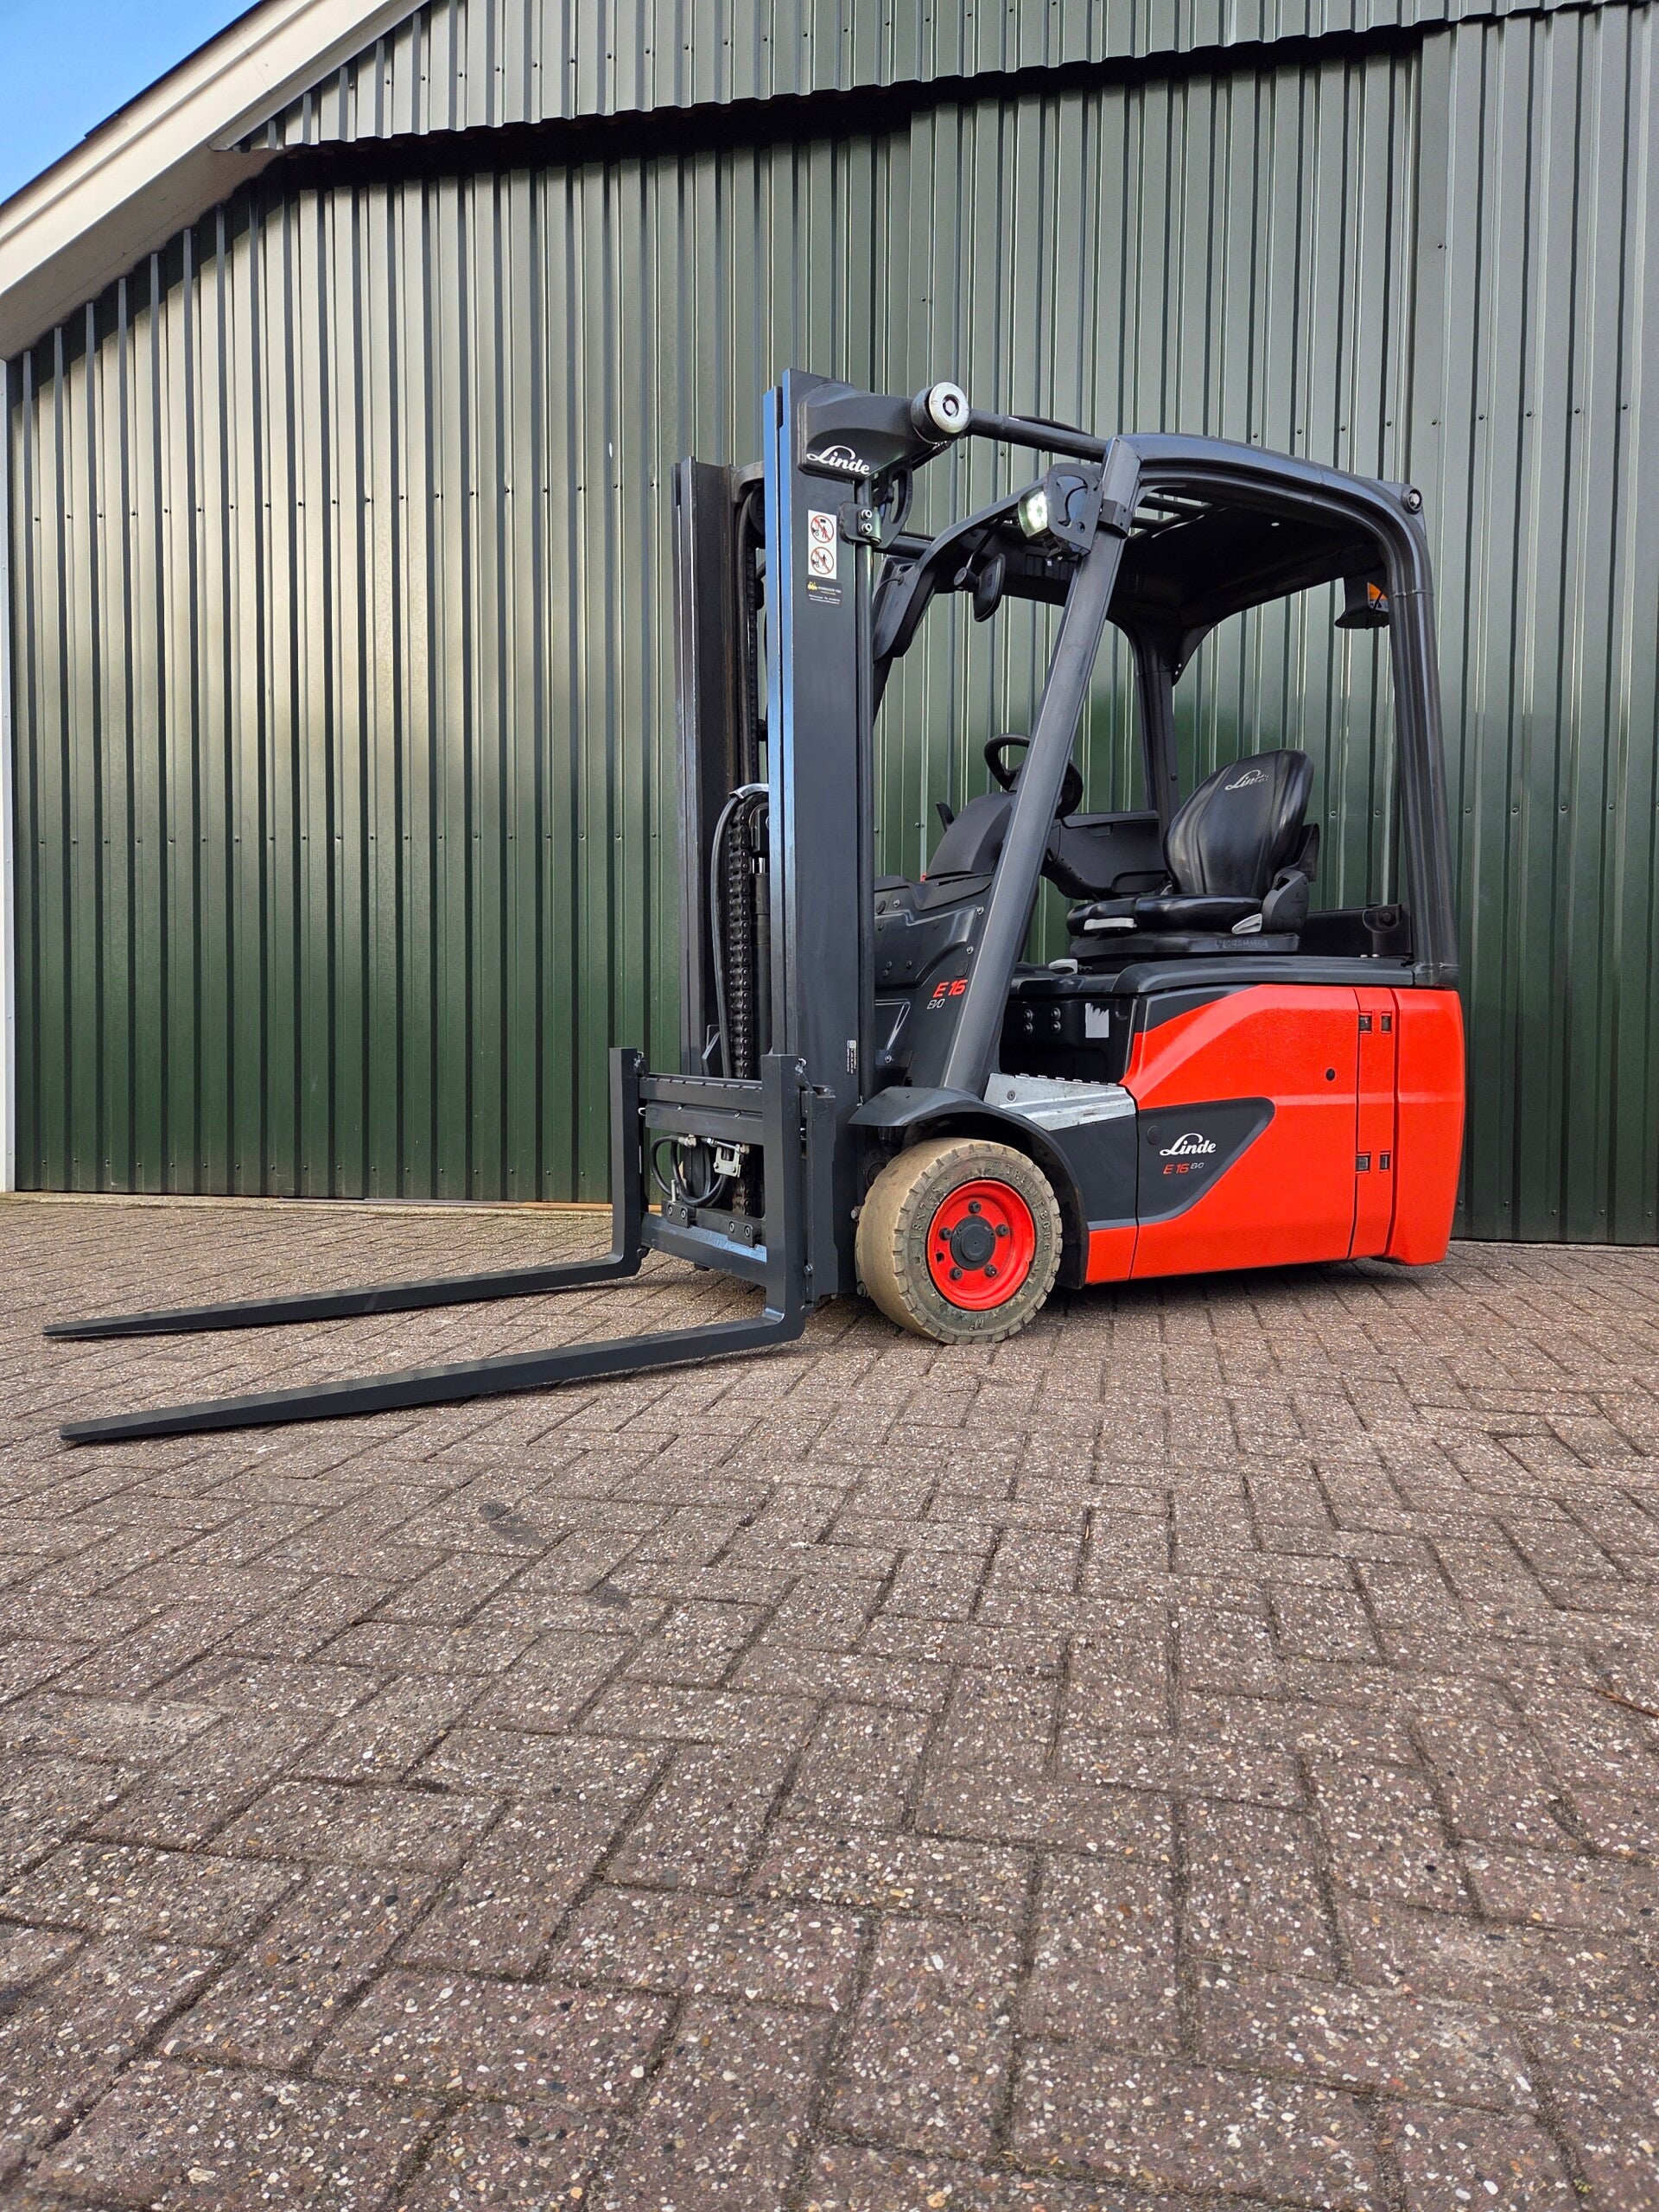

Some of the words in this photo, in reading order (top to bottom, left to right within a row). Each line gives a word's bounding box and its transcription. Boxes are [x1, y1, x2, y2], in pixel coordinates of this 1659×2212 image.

[805, 445, 870, 475] Linde
[932, 982, 950, 998] E
[948, 979, 969, 996] 16
[1159, 1133, 1217, 1156] Linde
[1163, 1164, 1175, 1174] E
[1175, 1163, 1190, 1173] 16
